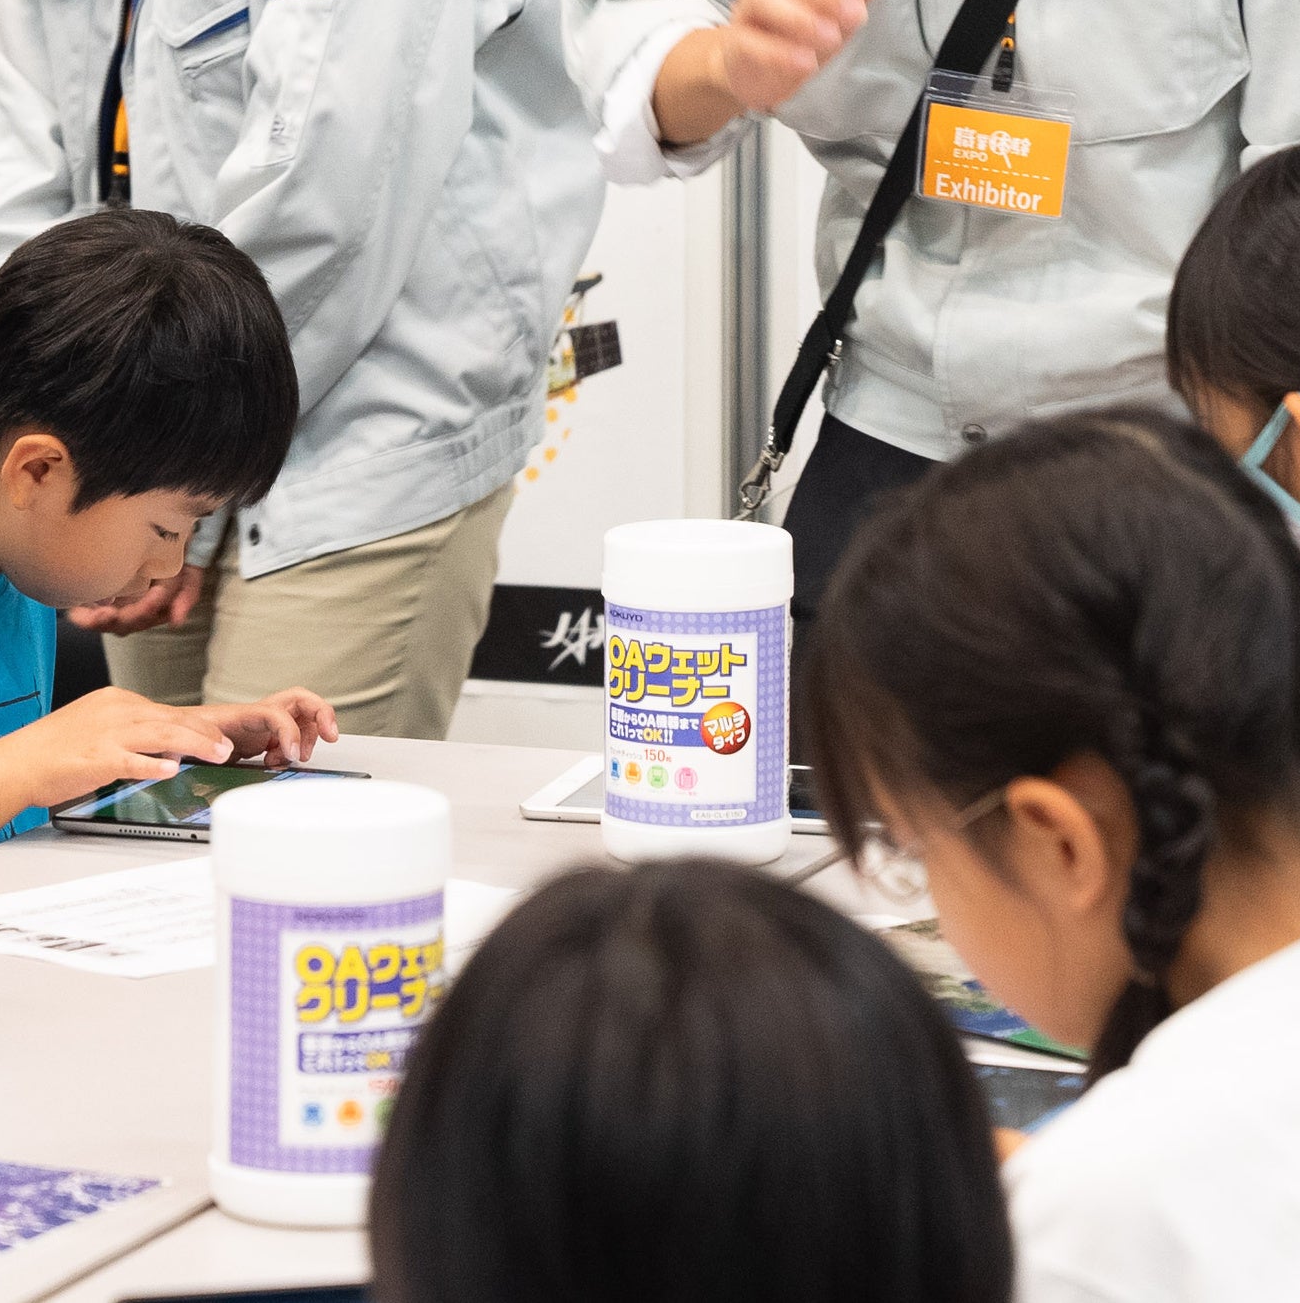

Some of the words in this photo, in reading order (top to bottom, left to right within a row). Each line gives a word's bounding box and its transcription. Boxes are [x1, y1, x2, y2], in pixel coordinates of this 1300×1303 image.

[953, 147, 988, 163] EXPO
[936, 173, 1043, 212] Exhibitor
[609, 635, 747, 677] OAウェット
